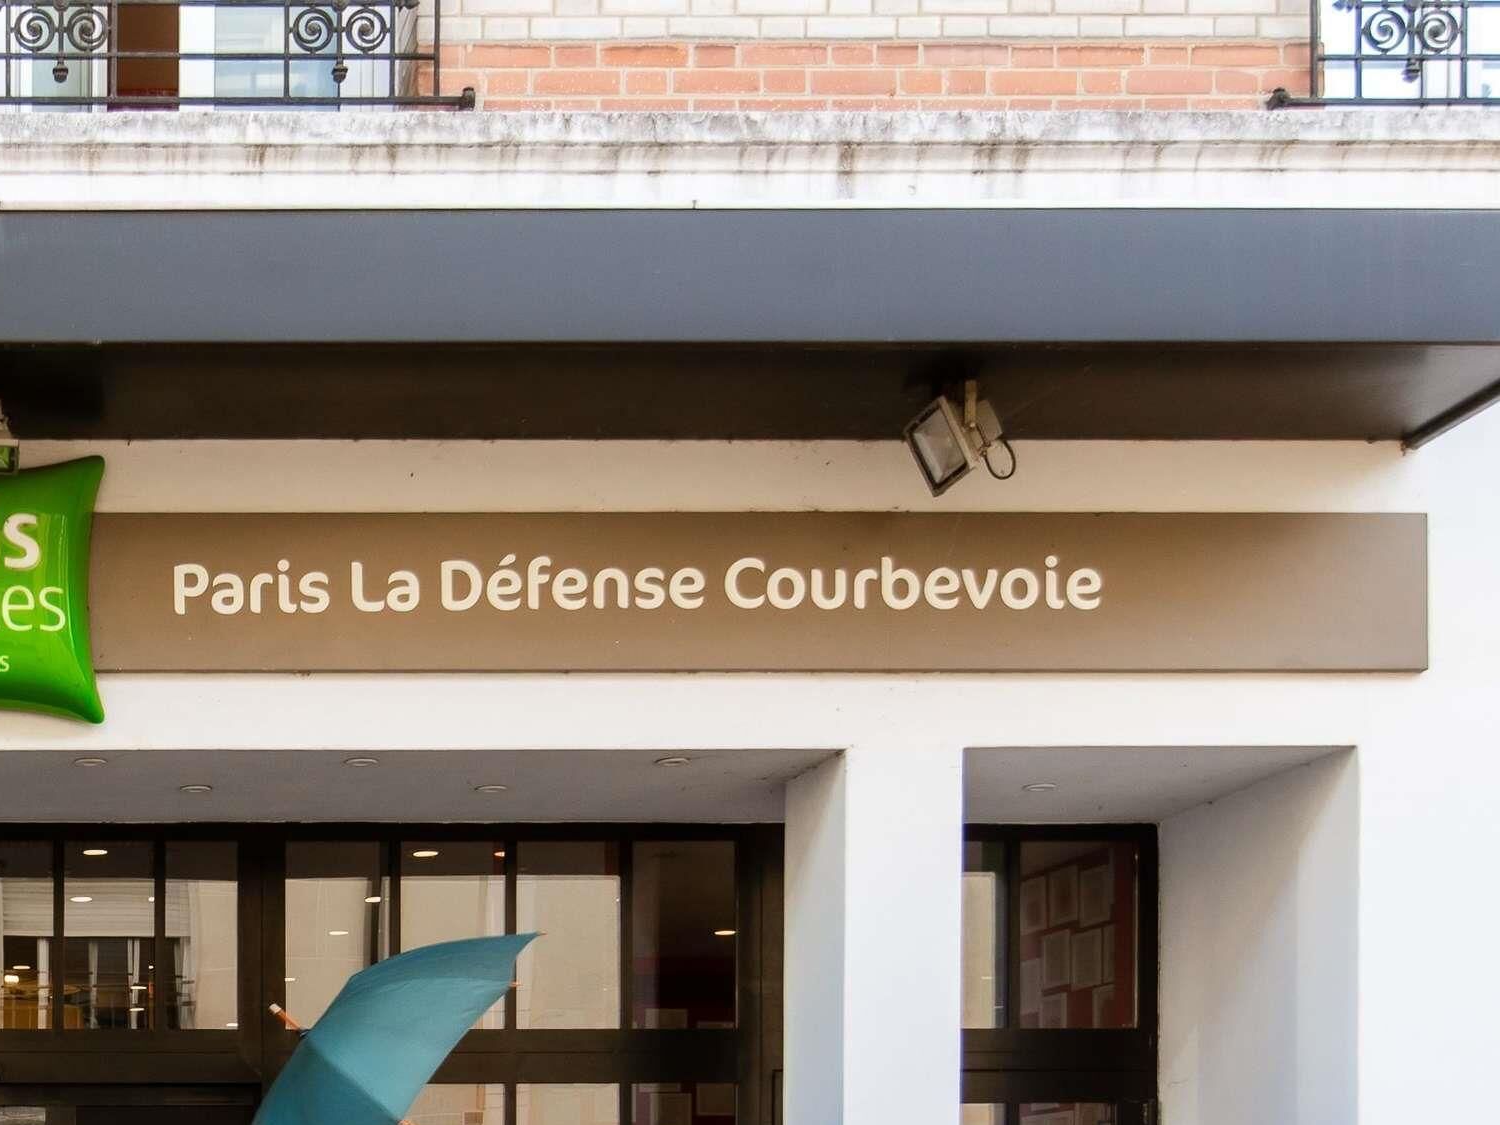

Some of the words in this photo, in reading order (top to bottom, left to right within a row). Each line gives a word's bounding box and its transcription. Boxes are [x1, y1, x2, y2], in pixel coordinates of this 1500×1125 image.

[173, 559, 331, 615] Paris
[351, 561, 420, 613] La
[440, 553, 706, 611] Défense
[724, 555, 1102, 611] Courbevoie
